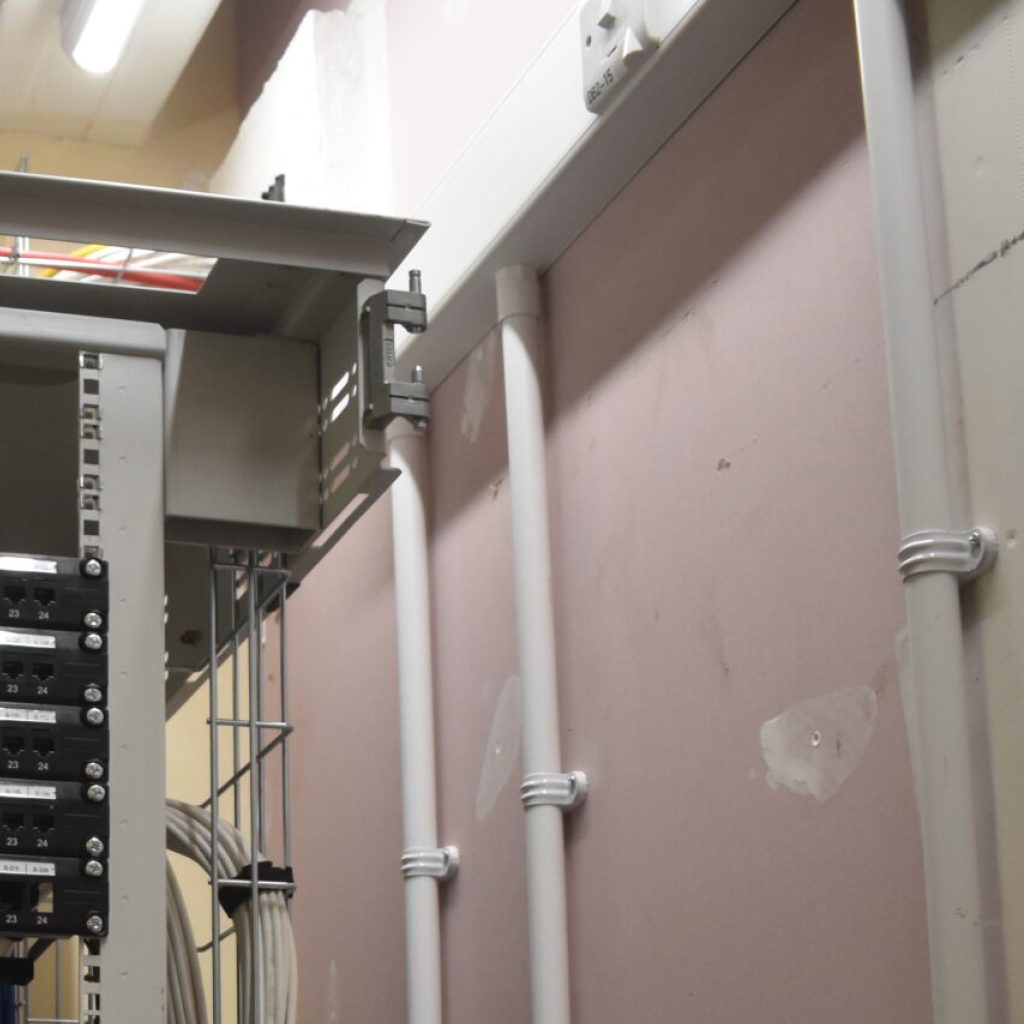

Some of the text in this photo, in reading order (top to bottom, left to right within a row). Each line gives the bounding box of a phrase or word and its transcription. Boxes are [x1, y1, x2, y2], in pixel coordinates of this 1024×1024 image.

[8, 609, 20, 618] 23
[38, 611, 49, 620] 24
[8, 760, 19, 769] 23
[38, 762, 48, 770] 24
[6, 914, 18, 924] 23
[37, 916, 48, 924] 24
